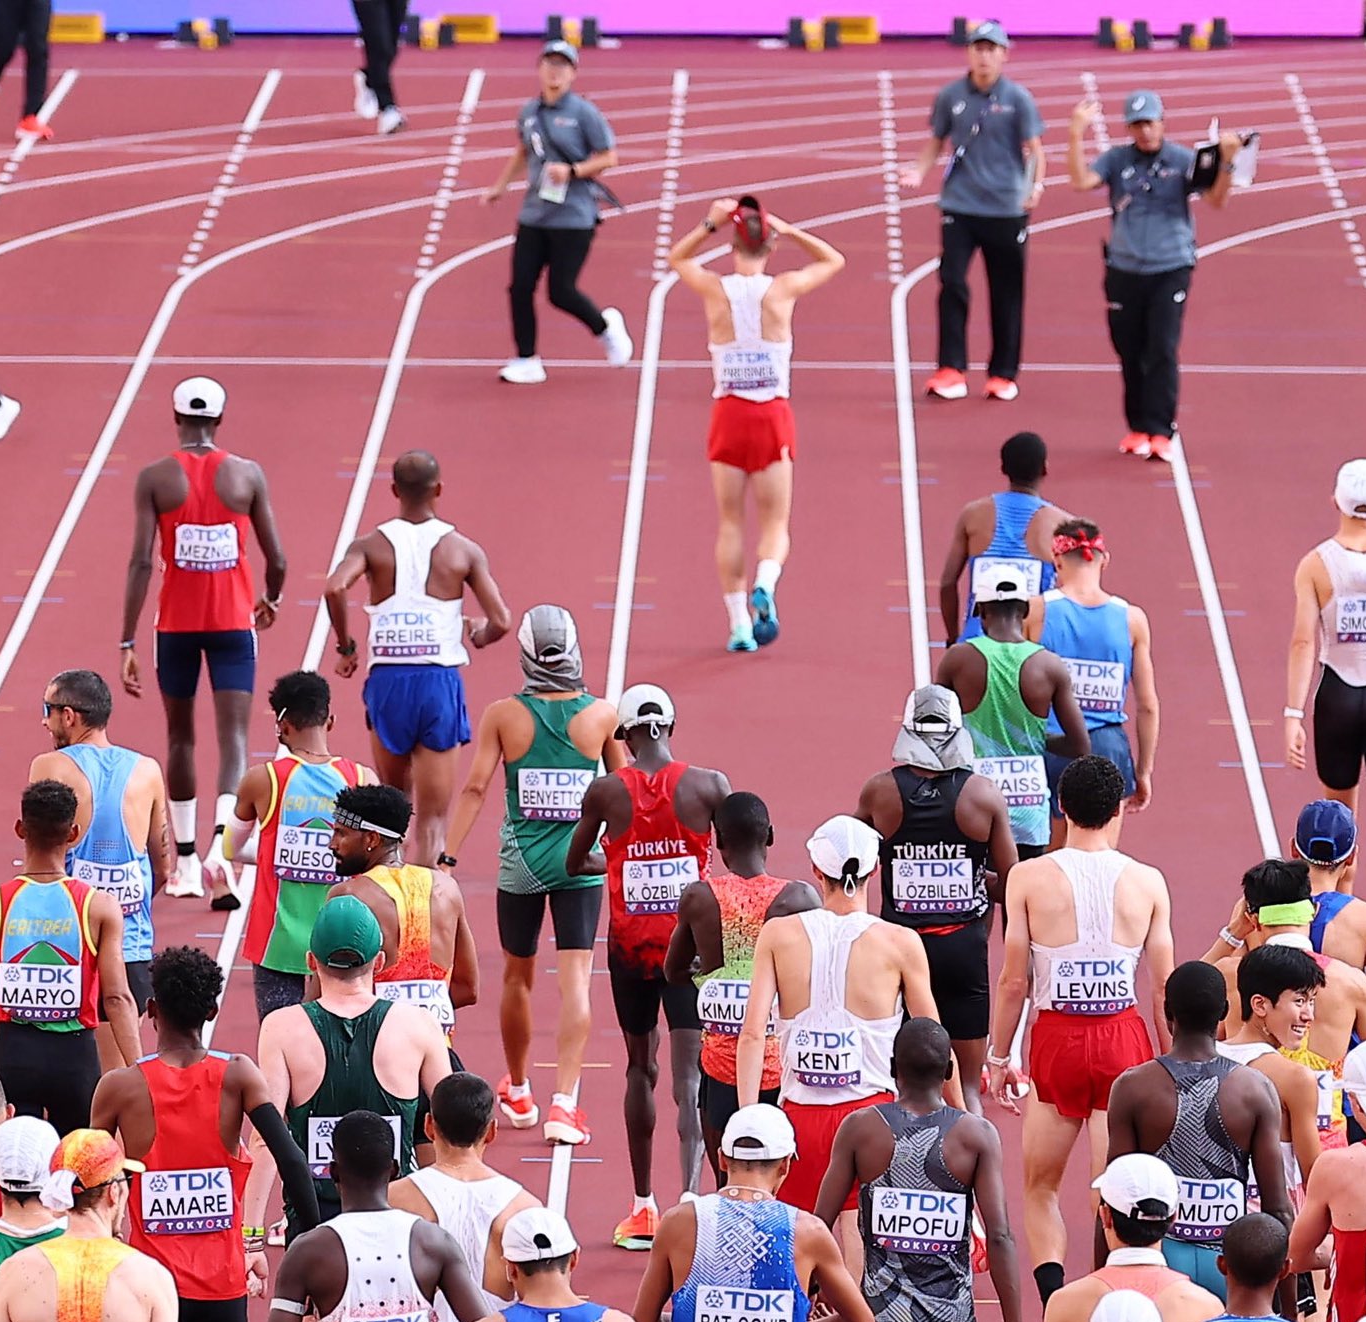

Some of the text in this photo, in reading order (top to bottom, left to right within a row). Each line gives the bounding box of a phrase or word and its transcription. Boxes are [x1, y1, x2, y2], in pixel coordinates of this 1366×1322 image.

[194, 527, 230, 542] TDK
[392, 612, 433, 625] TDK
[375, 629, 436, 643] FREIRE
[1073, 663, 1116, 678] TDK
[995, 760, 1040, 773] TDK
[541, 772, 586, 786] TDK
[522, 788, 583, 807] BENYETTO
[279, 849, 335, 869] RUESO
[893, 841, 966, 860] TÜRKİYE
[93, 865, 137, 882] TDK
[643, 860, 691, 879] TDK
[914, 862, 965, 877] TDK
[627, 886, 639, 901] K.
[906, 881, 968, 900] ÖZBILEN
[21, 967, 73, 984] TDK
[1074, 959, 1126, 977] TDK
[2, 988, 75, 1006] MARYO
[401, 984, 443, 998] TDK
[1057, 981, 1129, 1000] LEVINS
[810, 1030, 856, 1049] TDK
[798, 1052, 850, 1071] KENT
[169, 1172, 224, 1191] TDK
[1182, 1181, 1236, 1199] TDK
[149, 1194, 228, 1217] AMARE
[900, 1192, 957, 1214] TDK
[878, 1215, 959, 1238] MPOFU
[724, 1291, 784, 1312] TDK
